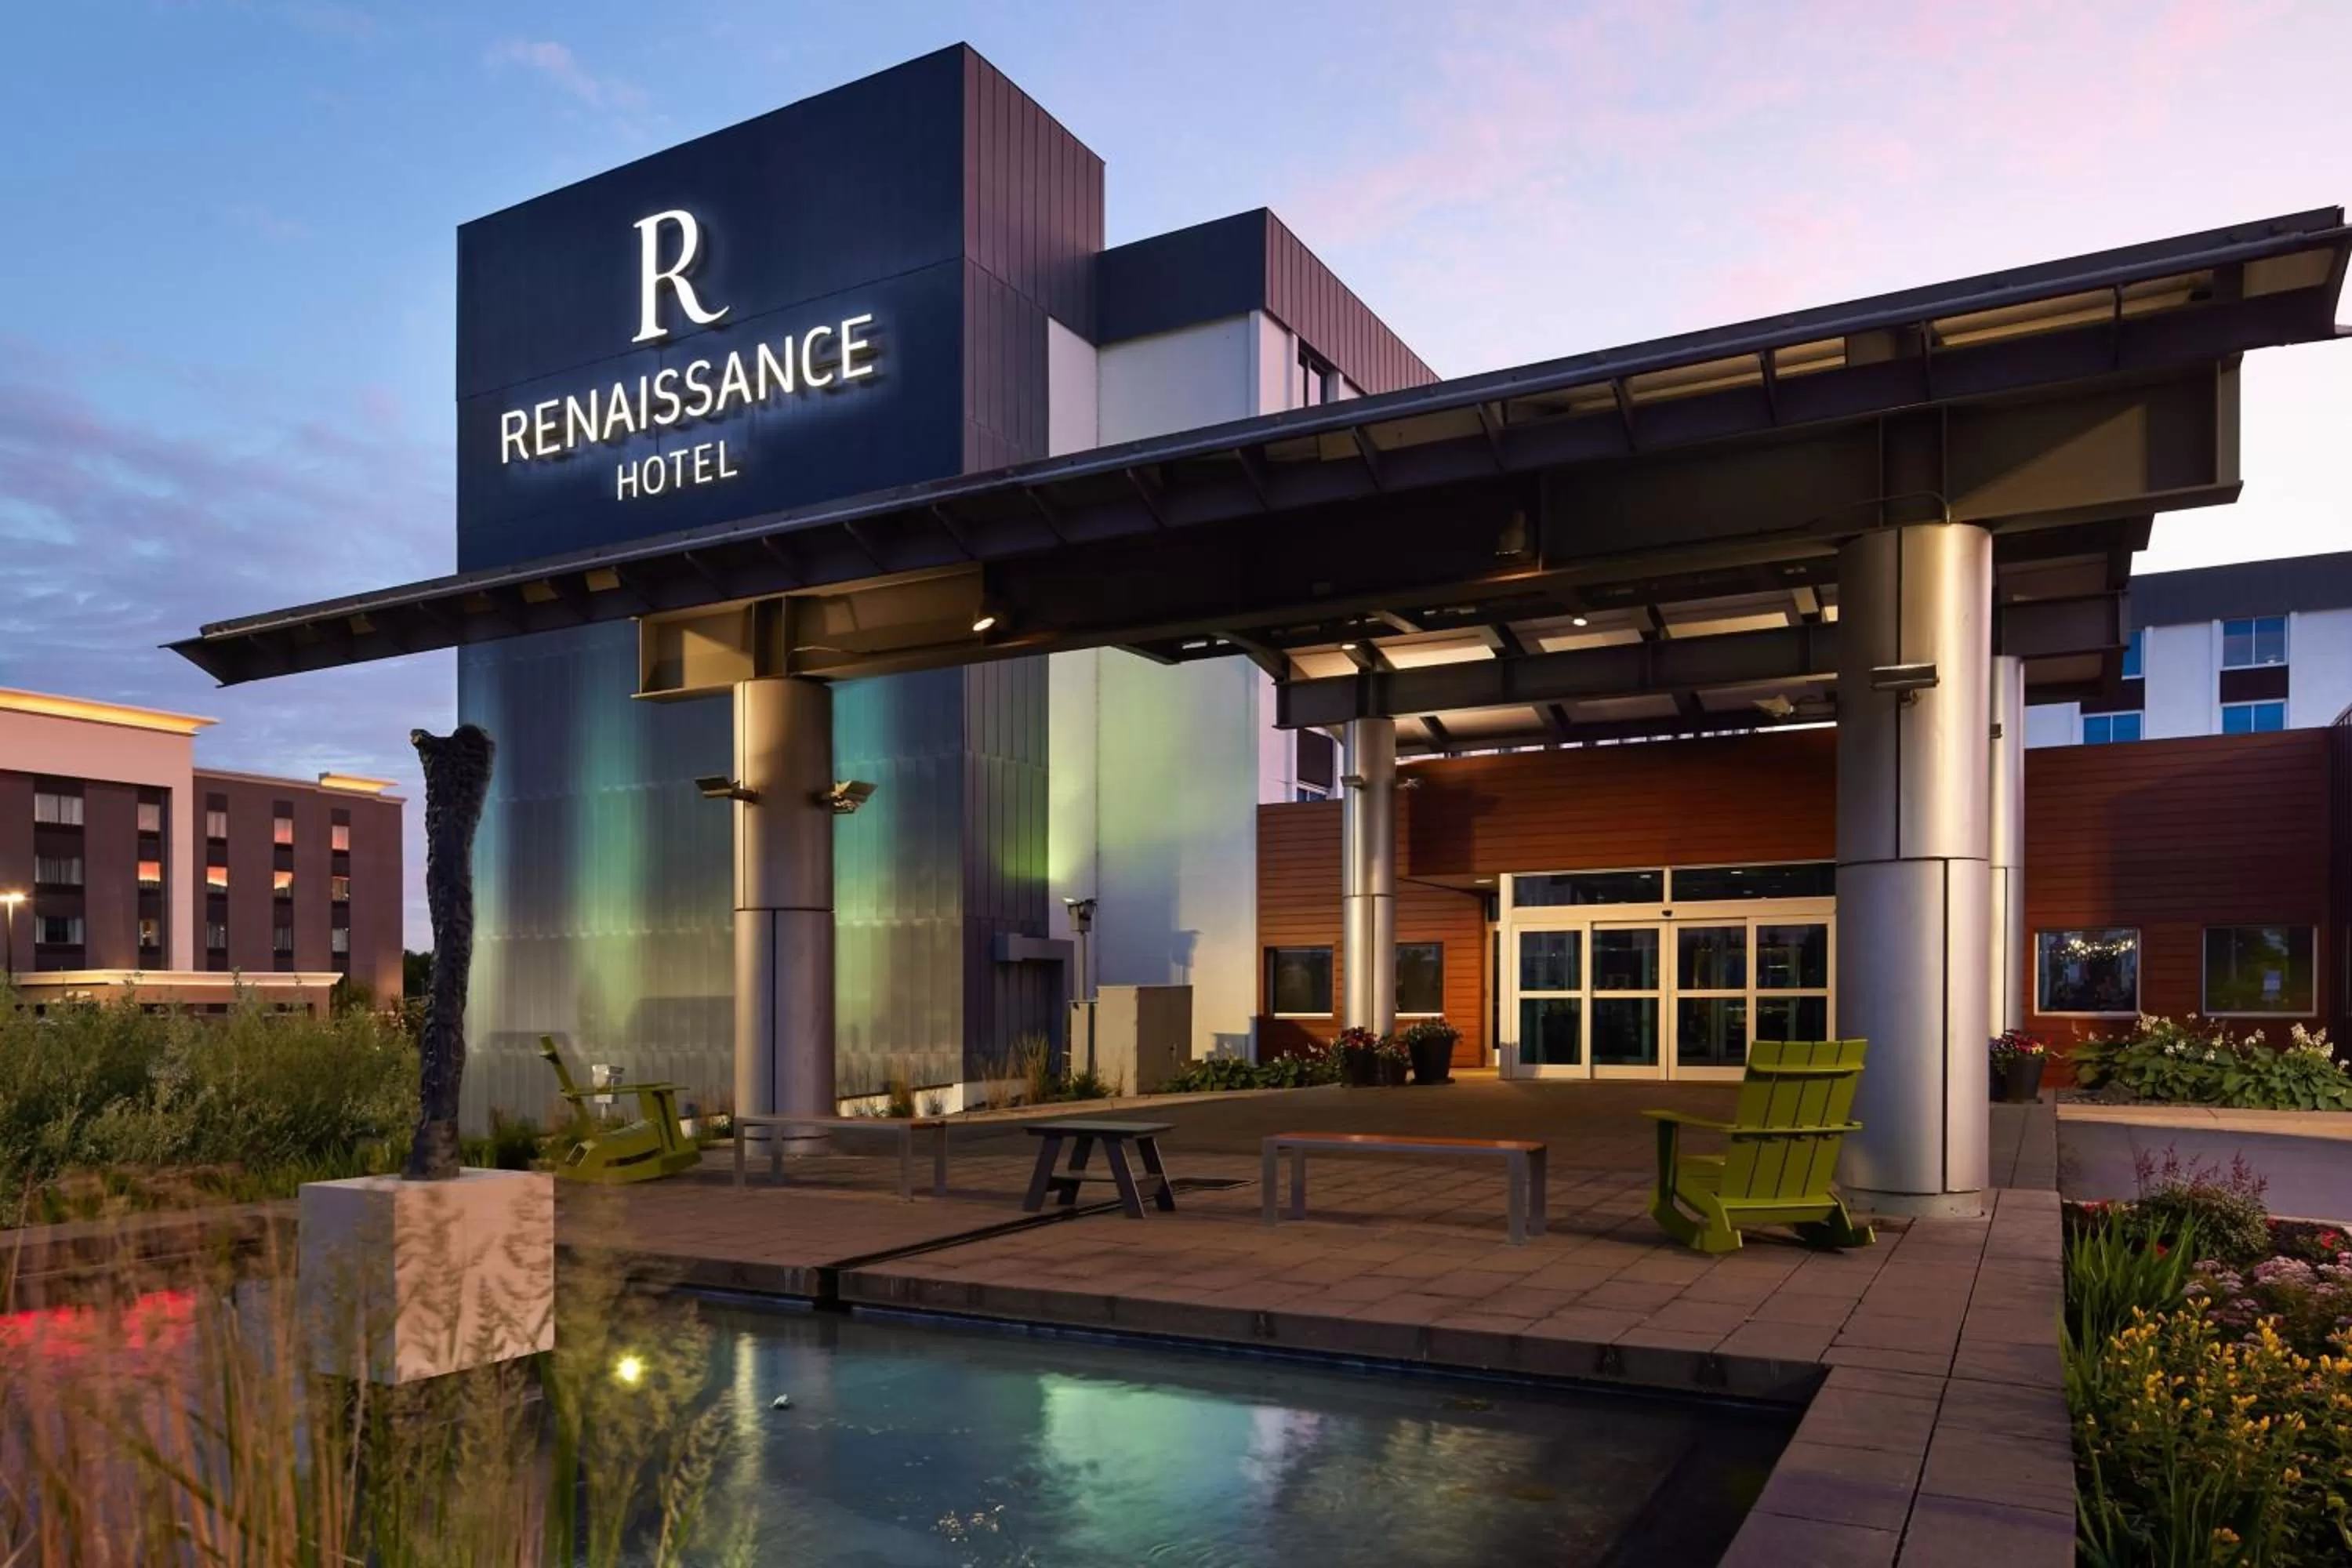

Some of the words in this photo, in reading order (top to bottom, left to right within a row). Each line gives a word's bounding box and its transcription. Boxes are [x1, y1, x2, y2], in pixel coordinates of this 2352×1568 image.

[632, 209, 729, 343] R
[500, 313, 873, 464] RENAISSANCE
[616, 440, 738, 501] HOTEL
